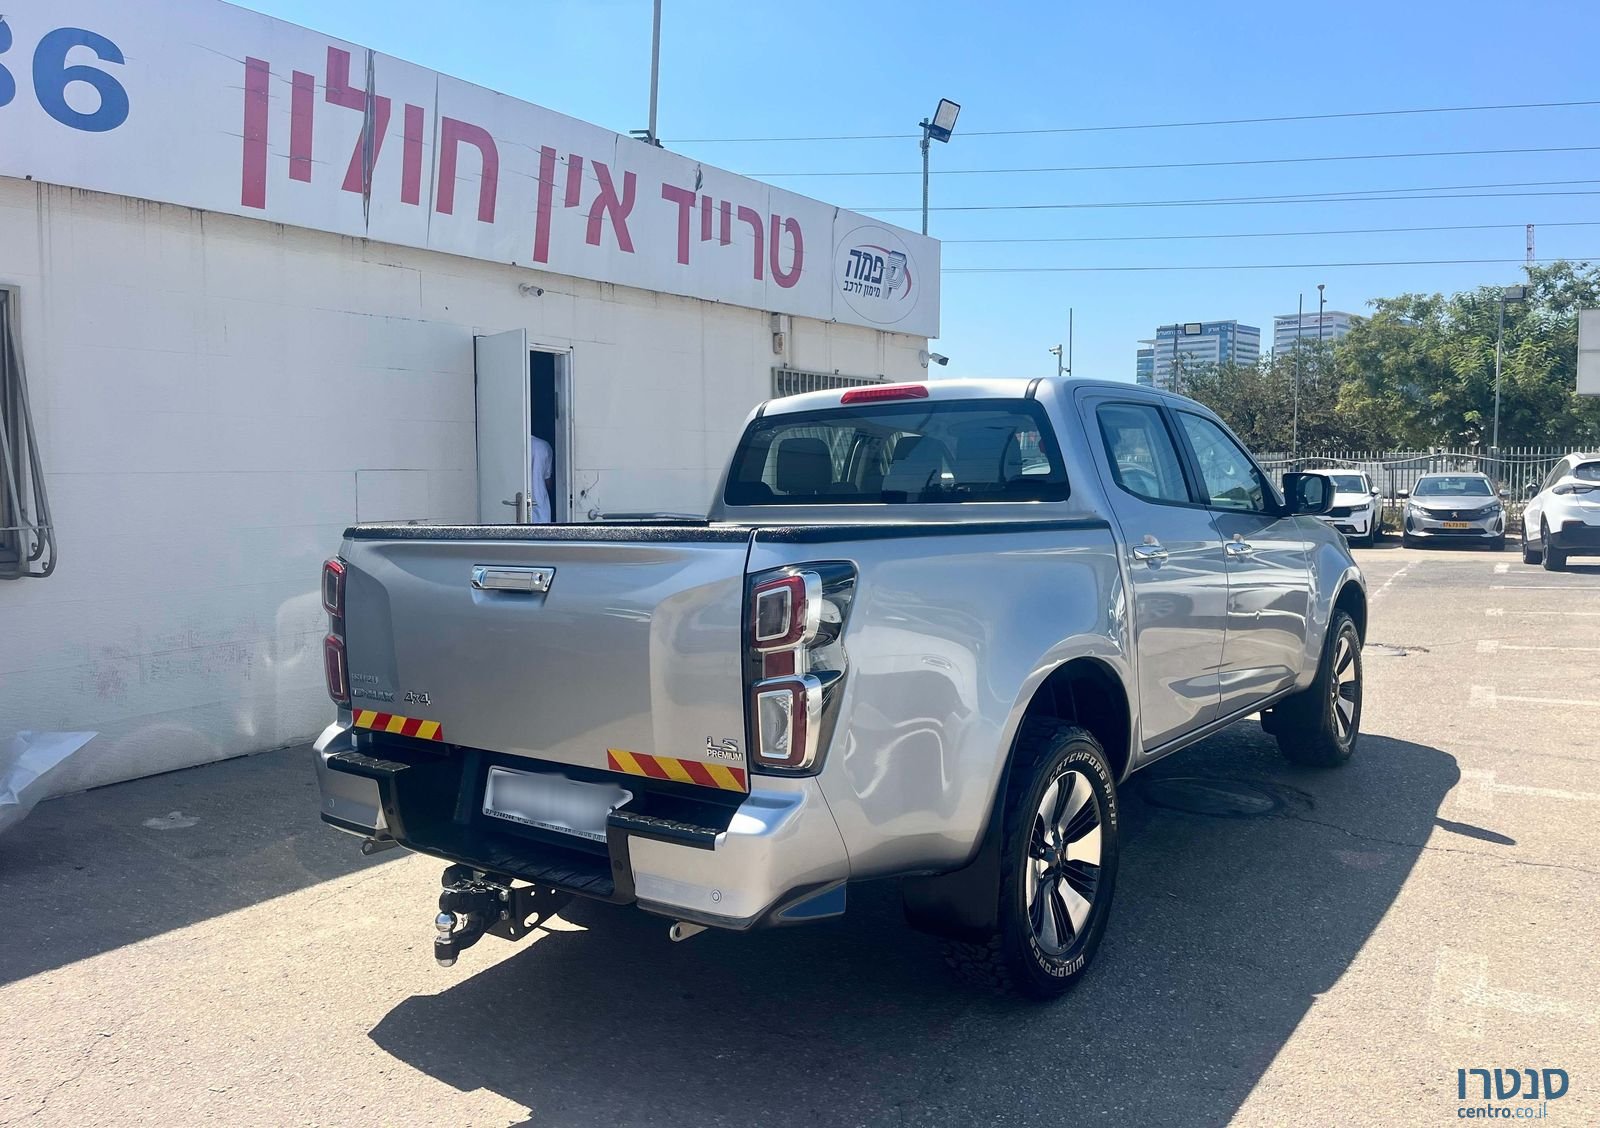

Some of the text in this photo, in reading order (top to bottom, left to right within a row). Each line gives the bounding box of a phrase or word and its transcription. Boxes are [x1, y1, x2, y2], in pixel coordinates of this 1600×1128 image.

[0, 19, 130, 133] 6
[241, 45, 804, 289] טרייד אין חולון
[843, 280, 881, 298] מימון לרכב
[706, 735, 739, 753] LS
[706, 749, 744, 761] PREMIUM
[1029, 936, 1085, 978] WINDFORCE
